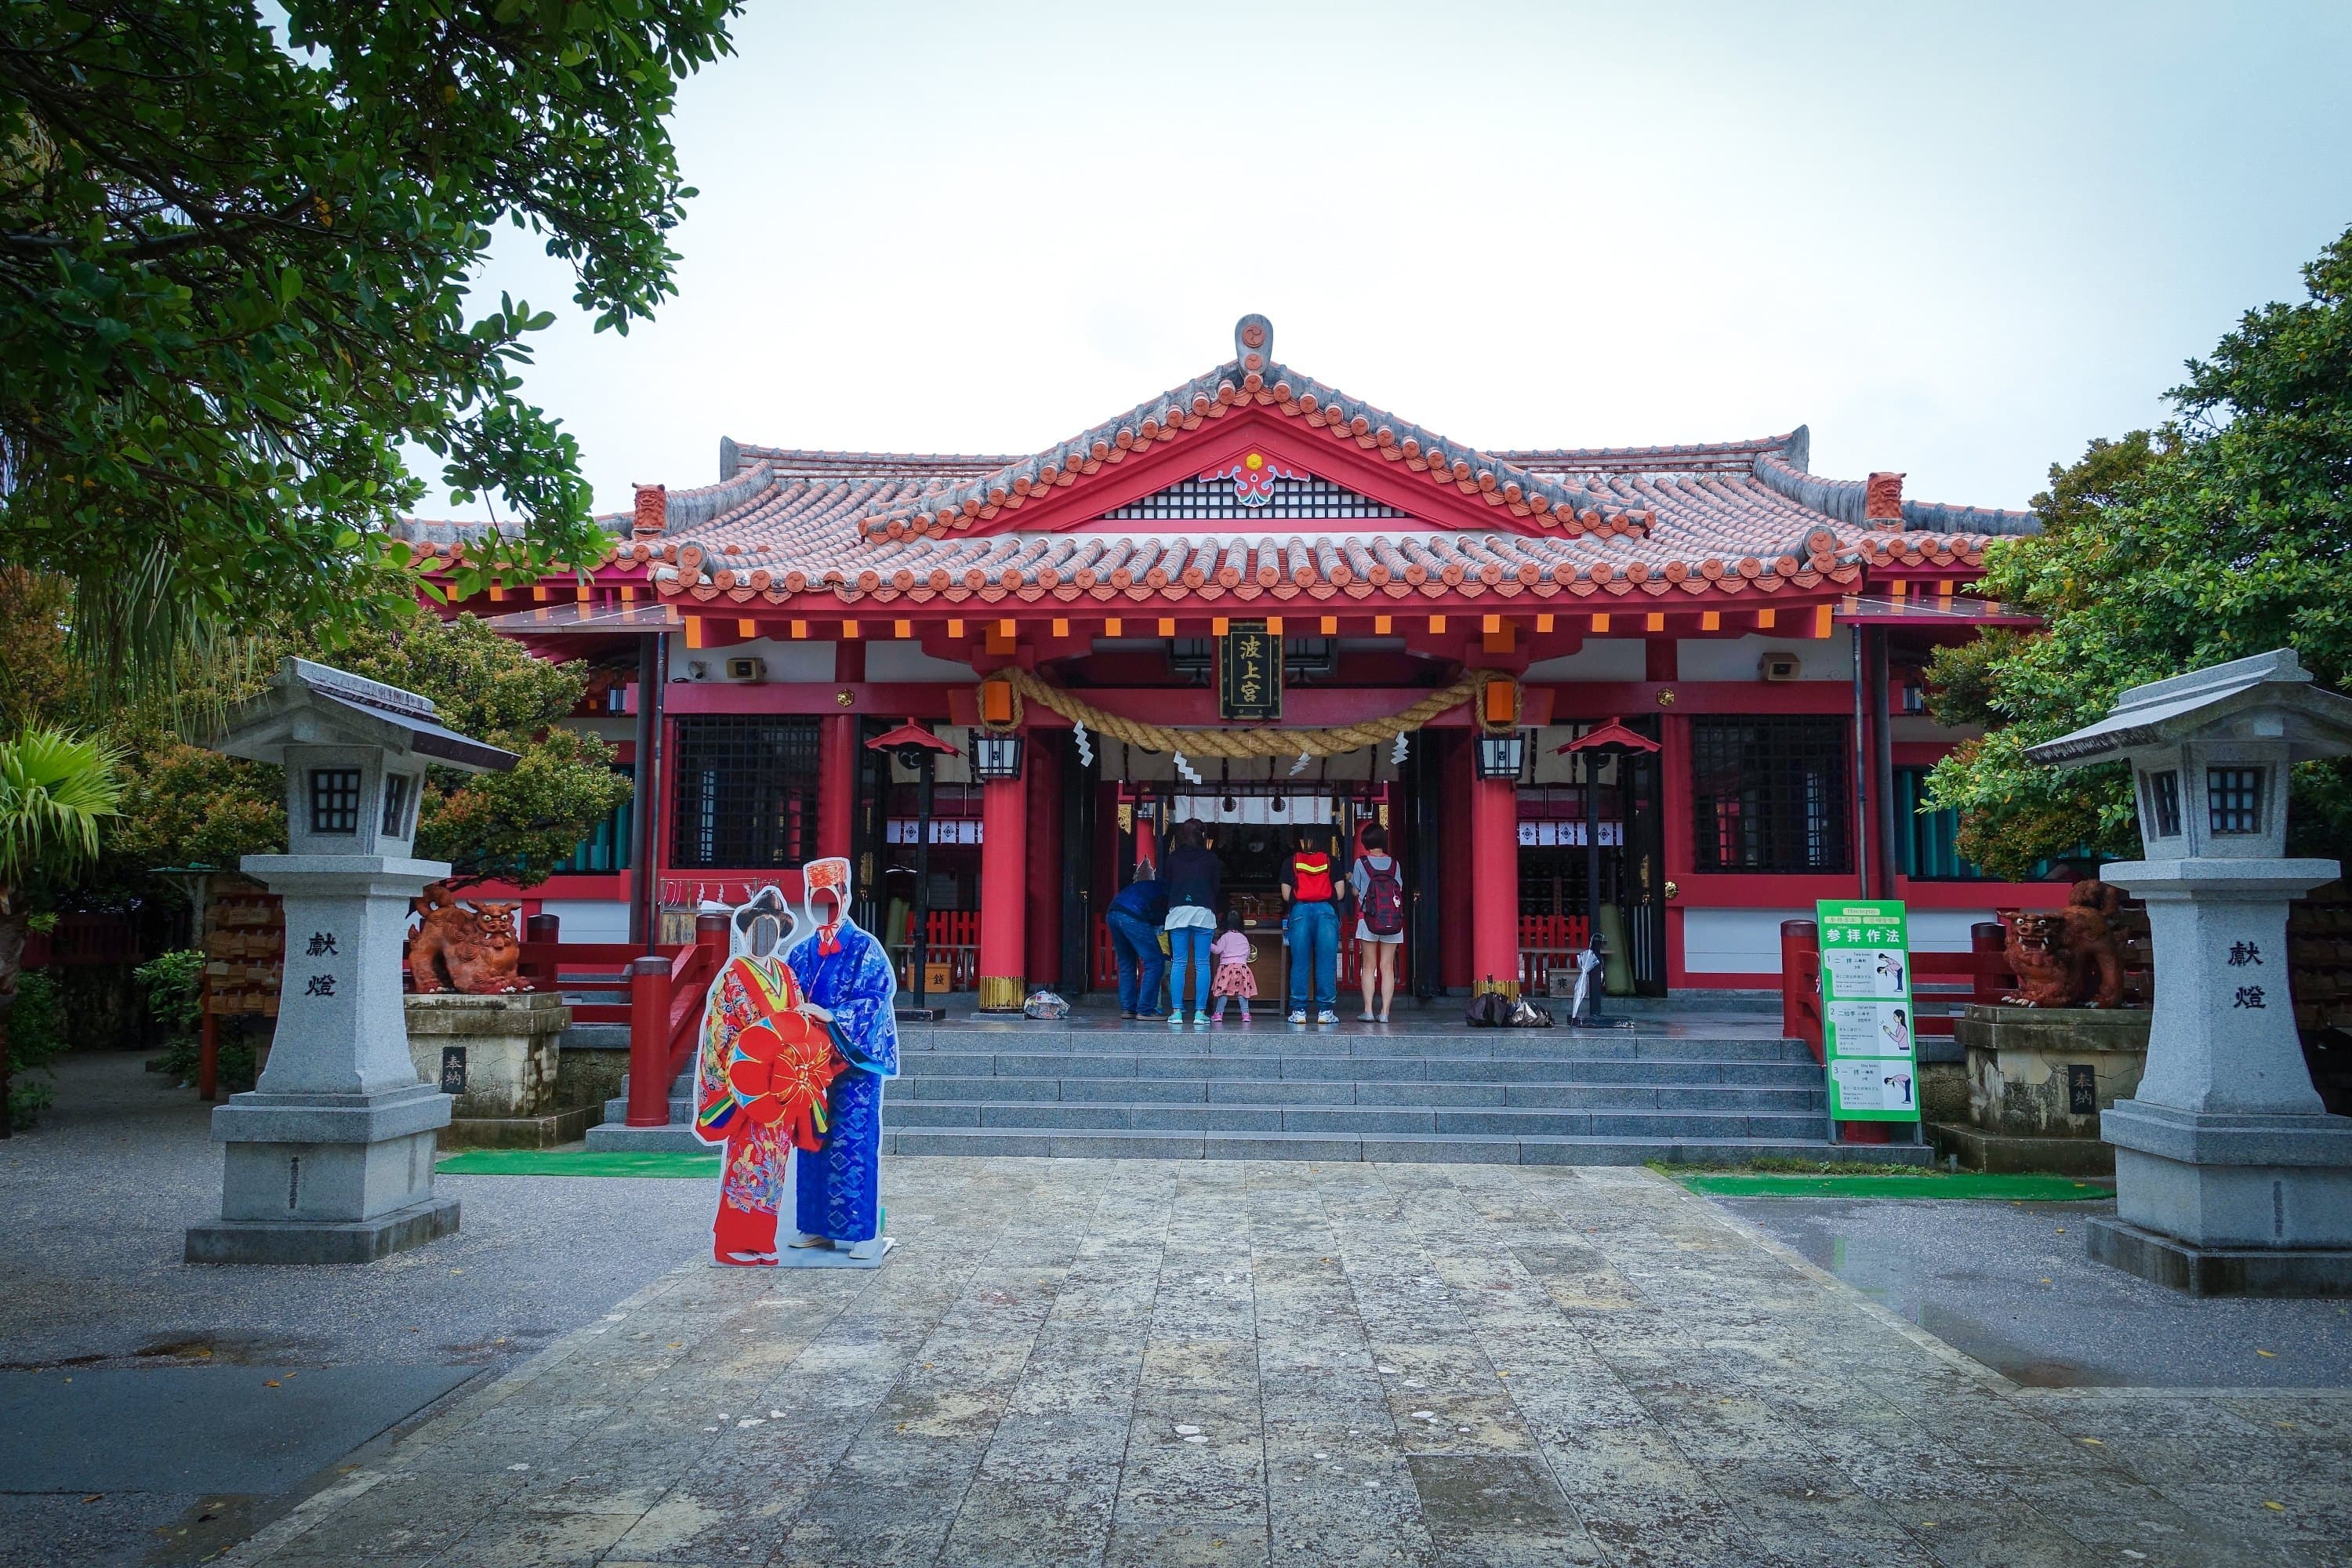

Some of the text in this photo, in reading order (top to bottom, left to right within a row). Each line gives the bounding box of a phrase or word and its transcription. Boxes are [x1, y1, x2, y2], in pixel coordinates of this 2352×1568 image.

[1240, 635, 1263, 702] 波上宮
[1827, 928, 1900, 942] 参拝作法
[445, 1054, 463, 1085] 奉納
[2074, 1073, 2092, 1105] 奉納
